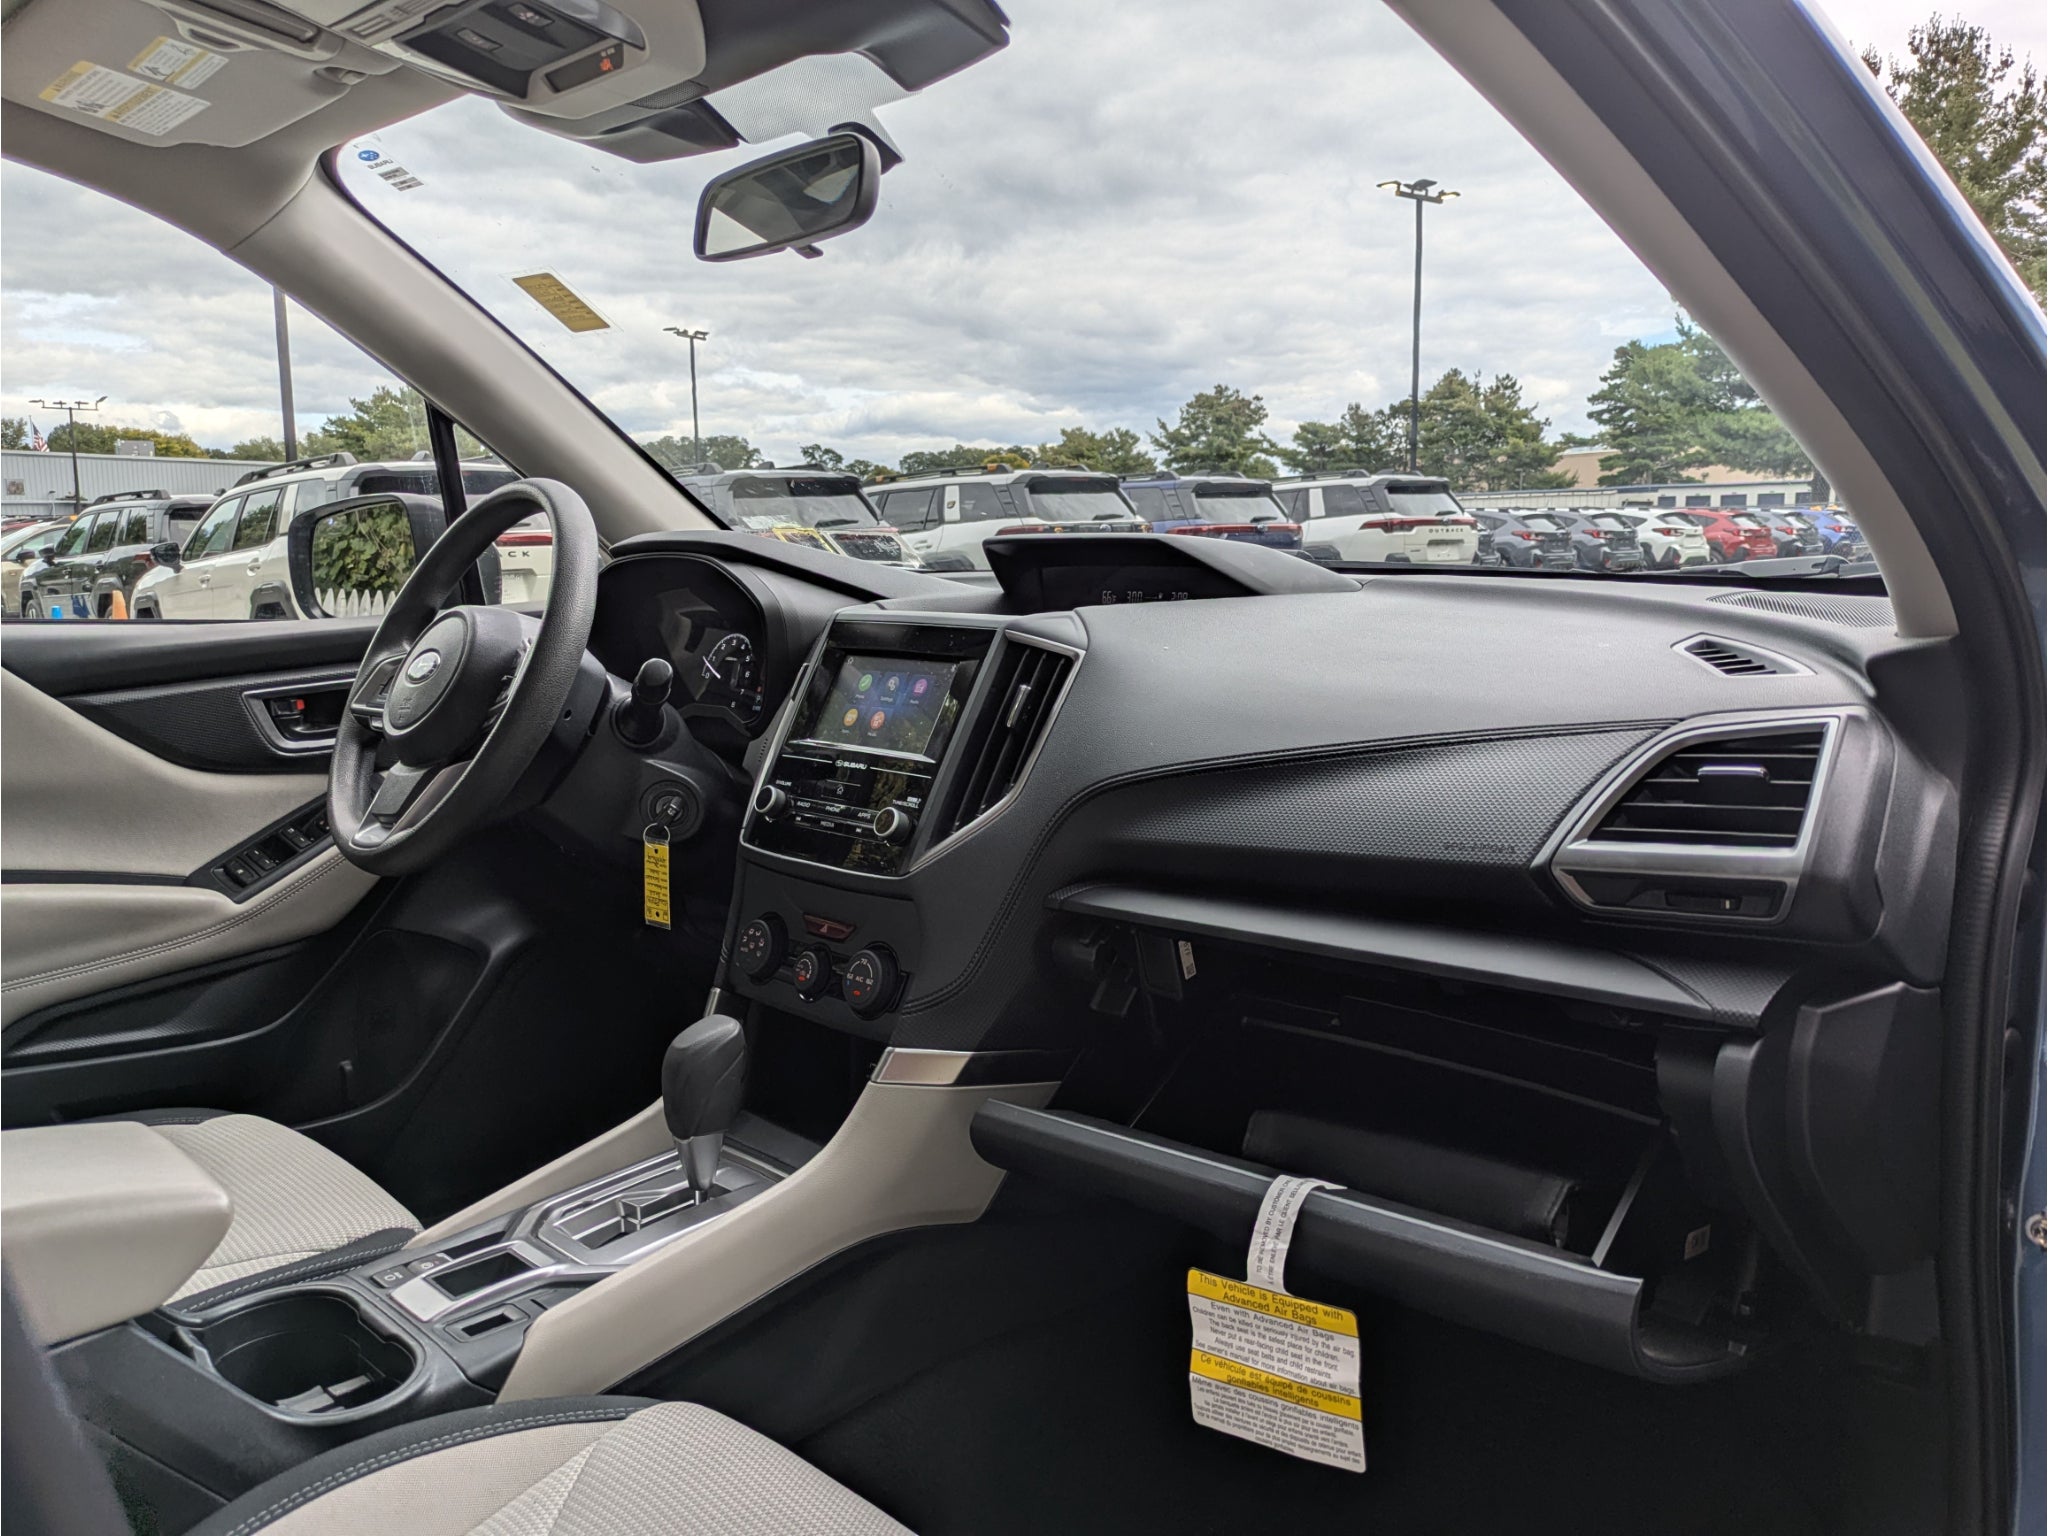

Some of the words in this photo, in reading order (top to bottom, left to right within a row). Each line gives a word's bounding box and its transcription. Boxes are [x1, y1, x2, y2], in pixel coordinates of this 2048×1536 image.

[843, 761, 868, 770] SUBARU
[1268, 1188, 1286, 1216] CUSTOMER
[1266, 1217, 1273, 1226] BY
[1274, 1227, 1282, 1240] PAR
[1200, 1273, 1217, 1287] This
[1221, 1280, 1256, 1297] Vehicle
[1259, 1288, 1268, 1300] is
[1271, 1294, 1318, 1314] Equipped
[1323, 1309, 1344, 1320] with
[1223, 1292, 1270, 1312] Advanced
[1274, 1305, 1287, 1316] Air
[1292, 1309, 1317, 1325] Bags
[1192, 1306, 1215, 1318] Children
[1238, 1318, 1253, 1328] killed
[1263, 1326, 1288, 1338] seriously
[1312, 1337, 1320, 1347] by
[1321, 1340, 1331, 1350] the
[1209, 1318, 1220, 1326] The
[1257, 1332, 1267, 1340] the
[1287, 1341, 1302, 1351] place
[1210, 1302, 1230, 1313] Even
[1233, 1308, 1250, 1319] with
[1253, 1313, 1294, 1330] Advanced
[1297, 1326, 1308, 1335] Air
[1312, 1329, 1334, 1342] Bags
[1210, 1326, 1226, 1336] Never
[1227, 1332, 1237, 1340] put
[1275, 1346, 1288, 1356] child
[1313, 1358, 1322, 1367] the
[1215, 1336, 1234, 1349] Always
[1235, 1345, 1246, 1353] use
[1261, 1352, 1275, 1361] belts
[1276, 1357, 1288, 1366] and
[1289, 1360, 1303, 1370] child
[1200, 1353, 1211, 1364] Ce
[1214, 1359, 1246, 1376] véhicule
[1249, 1370, 1262, 1382] est
[1265, 1376, 1293, 1391] équipé
[1296, 1385, 1308, 1394] de
[1312, 1390, 1351, 1406] coussins
[1261, 1362, 1275, 1371] more
[1276, 1366, 1308, 1382] information
[1310, 1377, 1327, 1388] about
[1214, 1384, 1232, 1393] avec
[1233, 1388, 1246, 1398] des
[1248, 1394, 1279, 1408] coussins
[1280, 1403, 1318, 1420] gonflables
[1320, 1415, 1360, 1431] intelligents
[1272, 1385, 1319, 1407] intelligents
